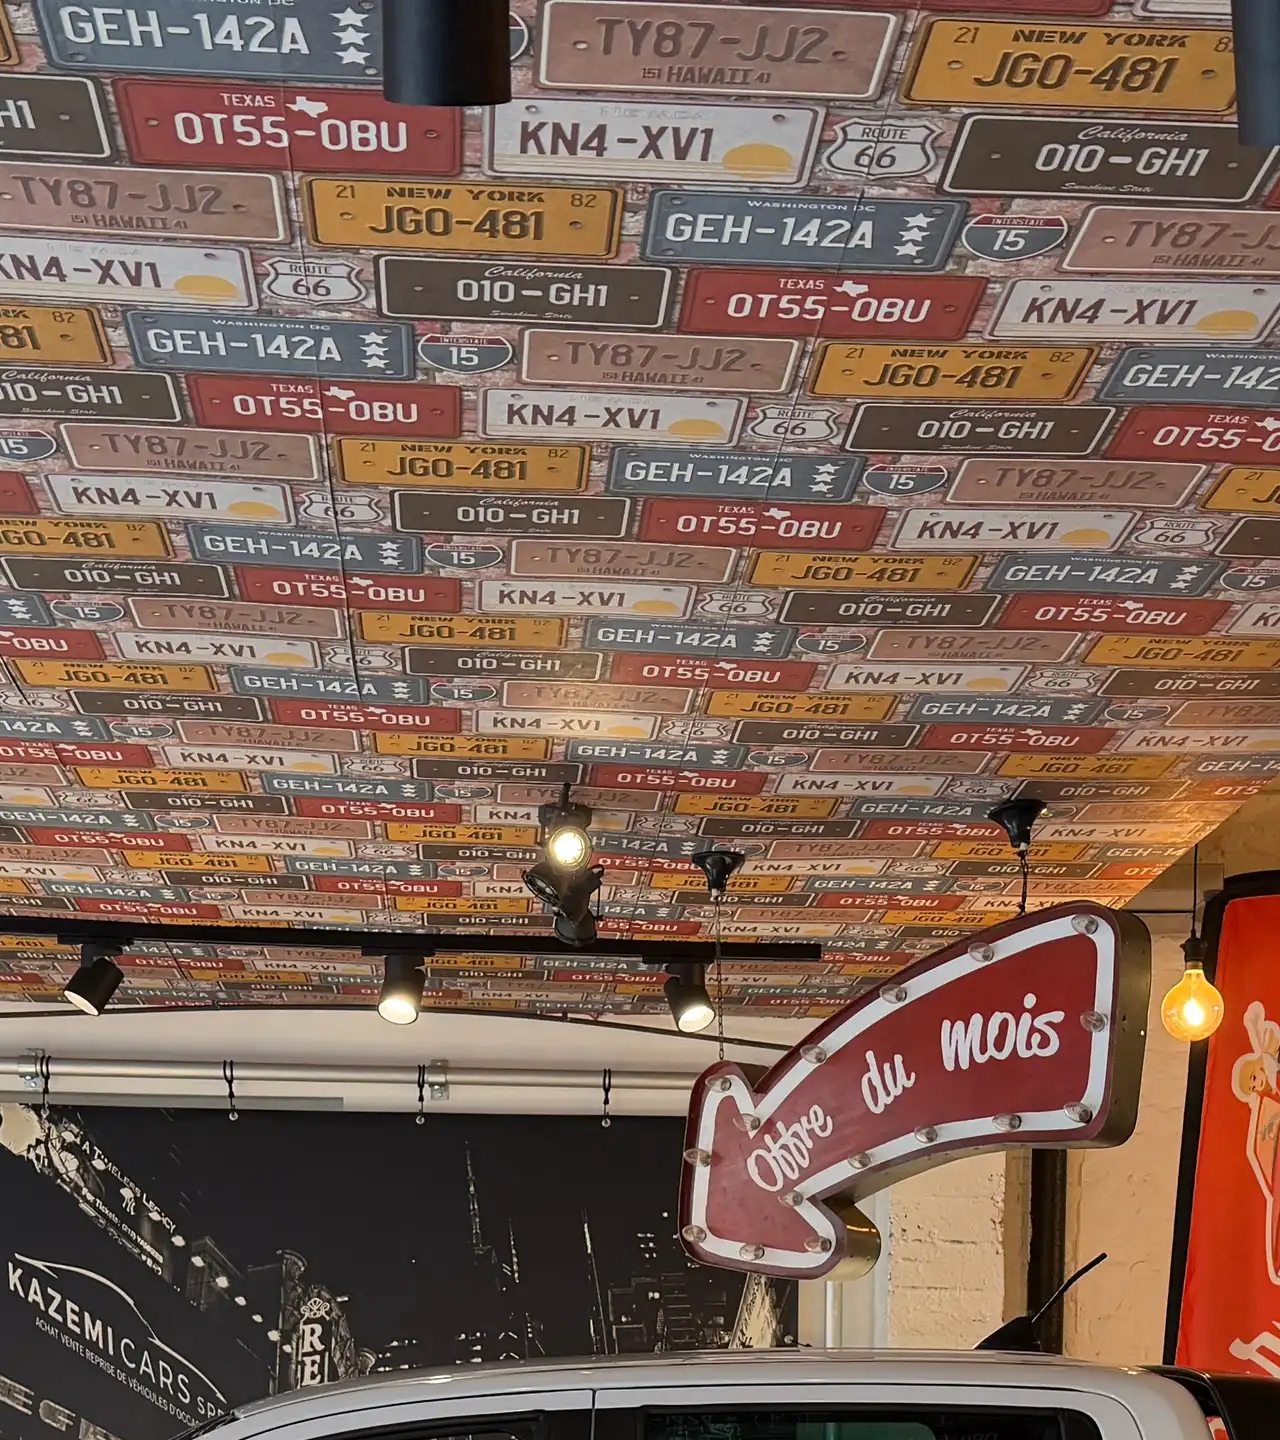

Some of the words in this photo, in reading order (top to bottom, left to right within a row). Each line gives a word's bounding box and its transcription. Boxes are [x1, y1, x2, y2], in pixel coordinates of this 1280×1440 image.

[55, 6, 310, 56] GEH-142A
[952, 26, 980, 45] 21
[1010, 28, 1089, 45] NEW
[1102, 31, 1191, 49] YORK
[666, 66, 752, 89] HAWAII
[219, 92, 276, 108] TEXAS
[855, 126, 908, 141] ROUTE
[1076, 124, 1189, 144] California
[853, 143, 897, 169] 66
[335, 183, 356, 199] 21
[386, 185, 453, 200] NEW
[465, 188, 545, 204] YORK
[569, 192, 597, 209] 82
[91, 213, 172, 232] HAWAII
[664, 212, 873, 249] GEH-142A
[992, 228, 1030, 251] 15
[286, 263, 331, 276] ROUTE
[291, 276, 332, 297] 66
[778, 277, 825, 290] TEXAS
[145, 328, 342, 361] GEH-142A
[746, 1103, 834, 1193] Offre
[860, 1050, 916, 1115] du
[940, 993, 1066, 1071] mois
[7, 1261, 114, 1356] KAZEMI
[120, 1338, 191, 1405] CARS
[35, 1316, 59, 1339] ACHAT
[60, 1331, 85, 1358] VENTE
[85, 1349, 116, 1377] REPRISE
[116, 1369, 128, 1385] DE
